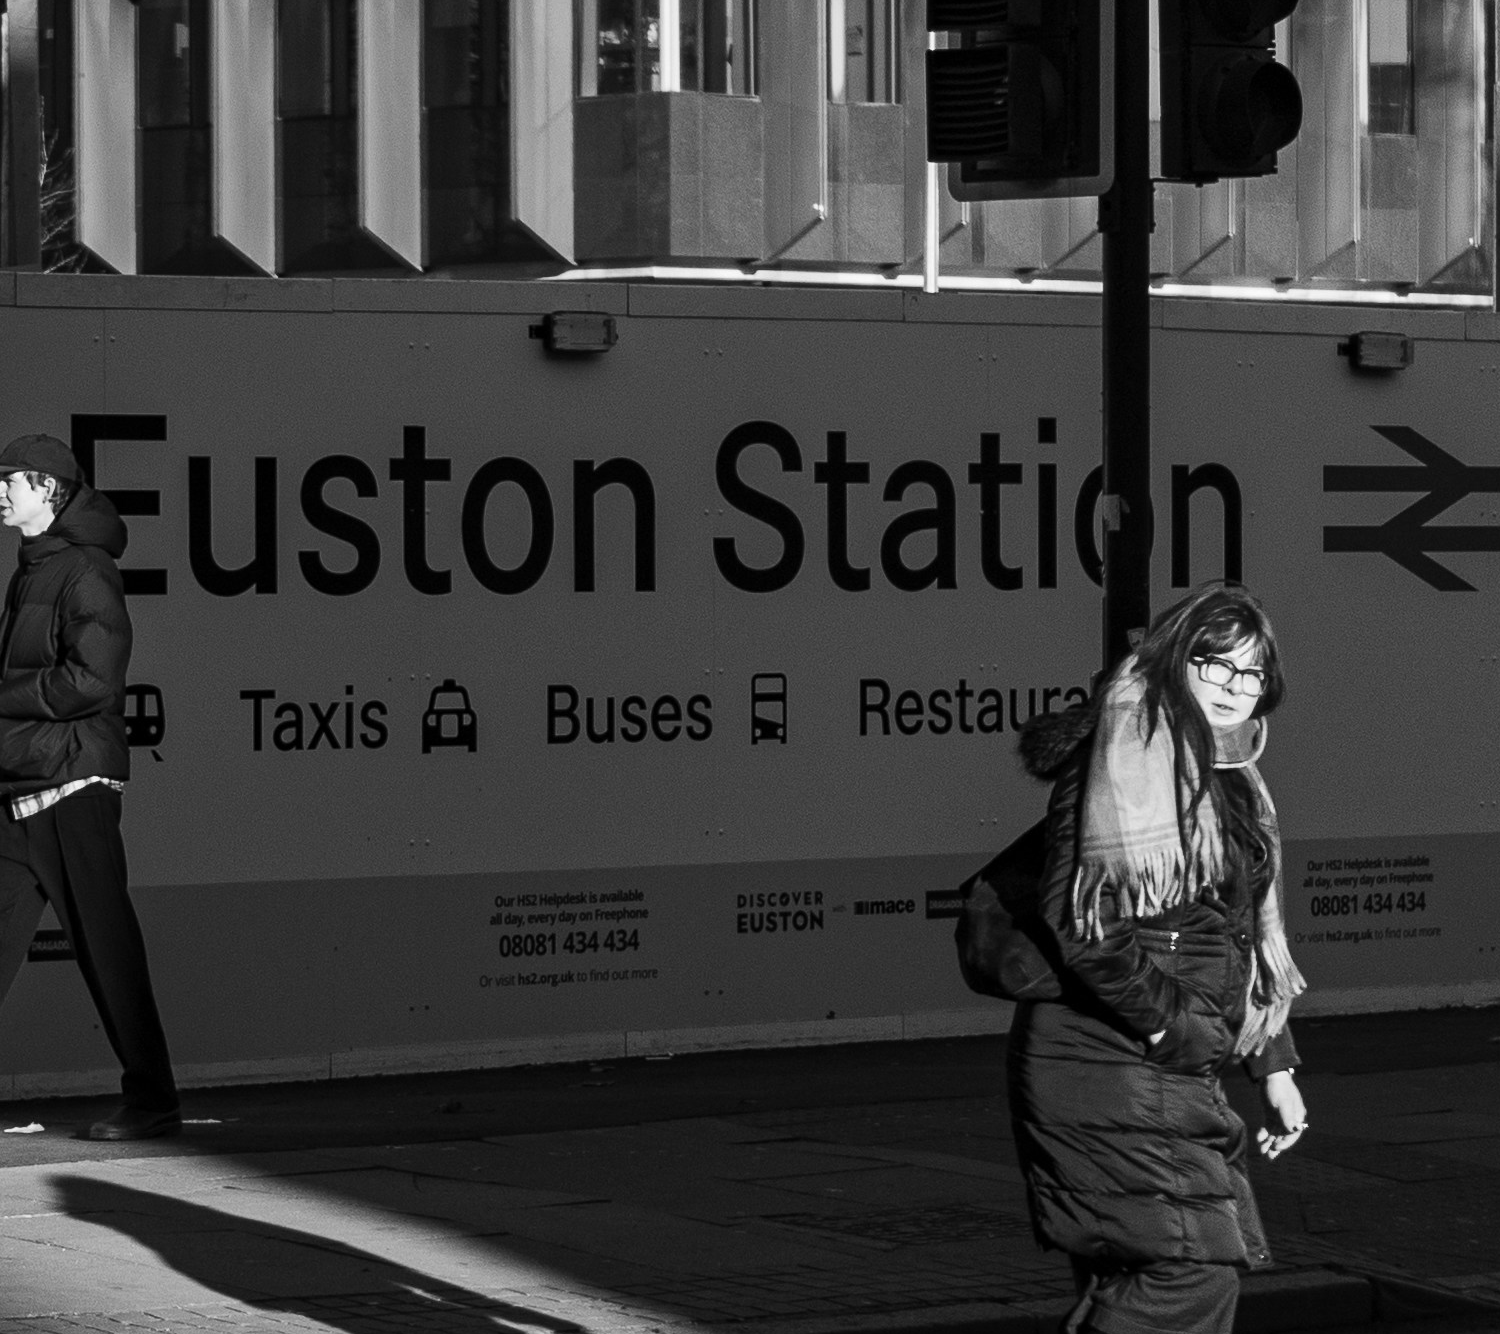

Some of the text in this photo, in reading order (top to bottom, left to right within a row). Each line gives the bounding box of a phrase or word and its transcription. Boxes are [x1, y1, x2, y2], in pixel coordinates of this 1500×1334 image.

[71, 414, 656, 597] Euston
[241, 686, 389, 753] Taxis
[547, 684, 711, 746] Buses
[495, 890, 644, 908] Our HS2 Helpdesk is available
[737, 891, 824, 909] DISCOVER
[870, 898, 916, 915] mace
[1311, 892, 1426, 916] 08081 434 434
[737, 910, 825, 934] EUSTON
[499, 929, 640, 957] 08081 434 434
